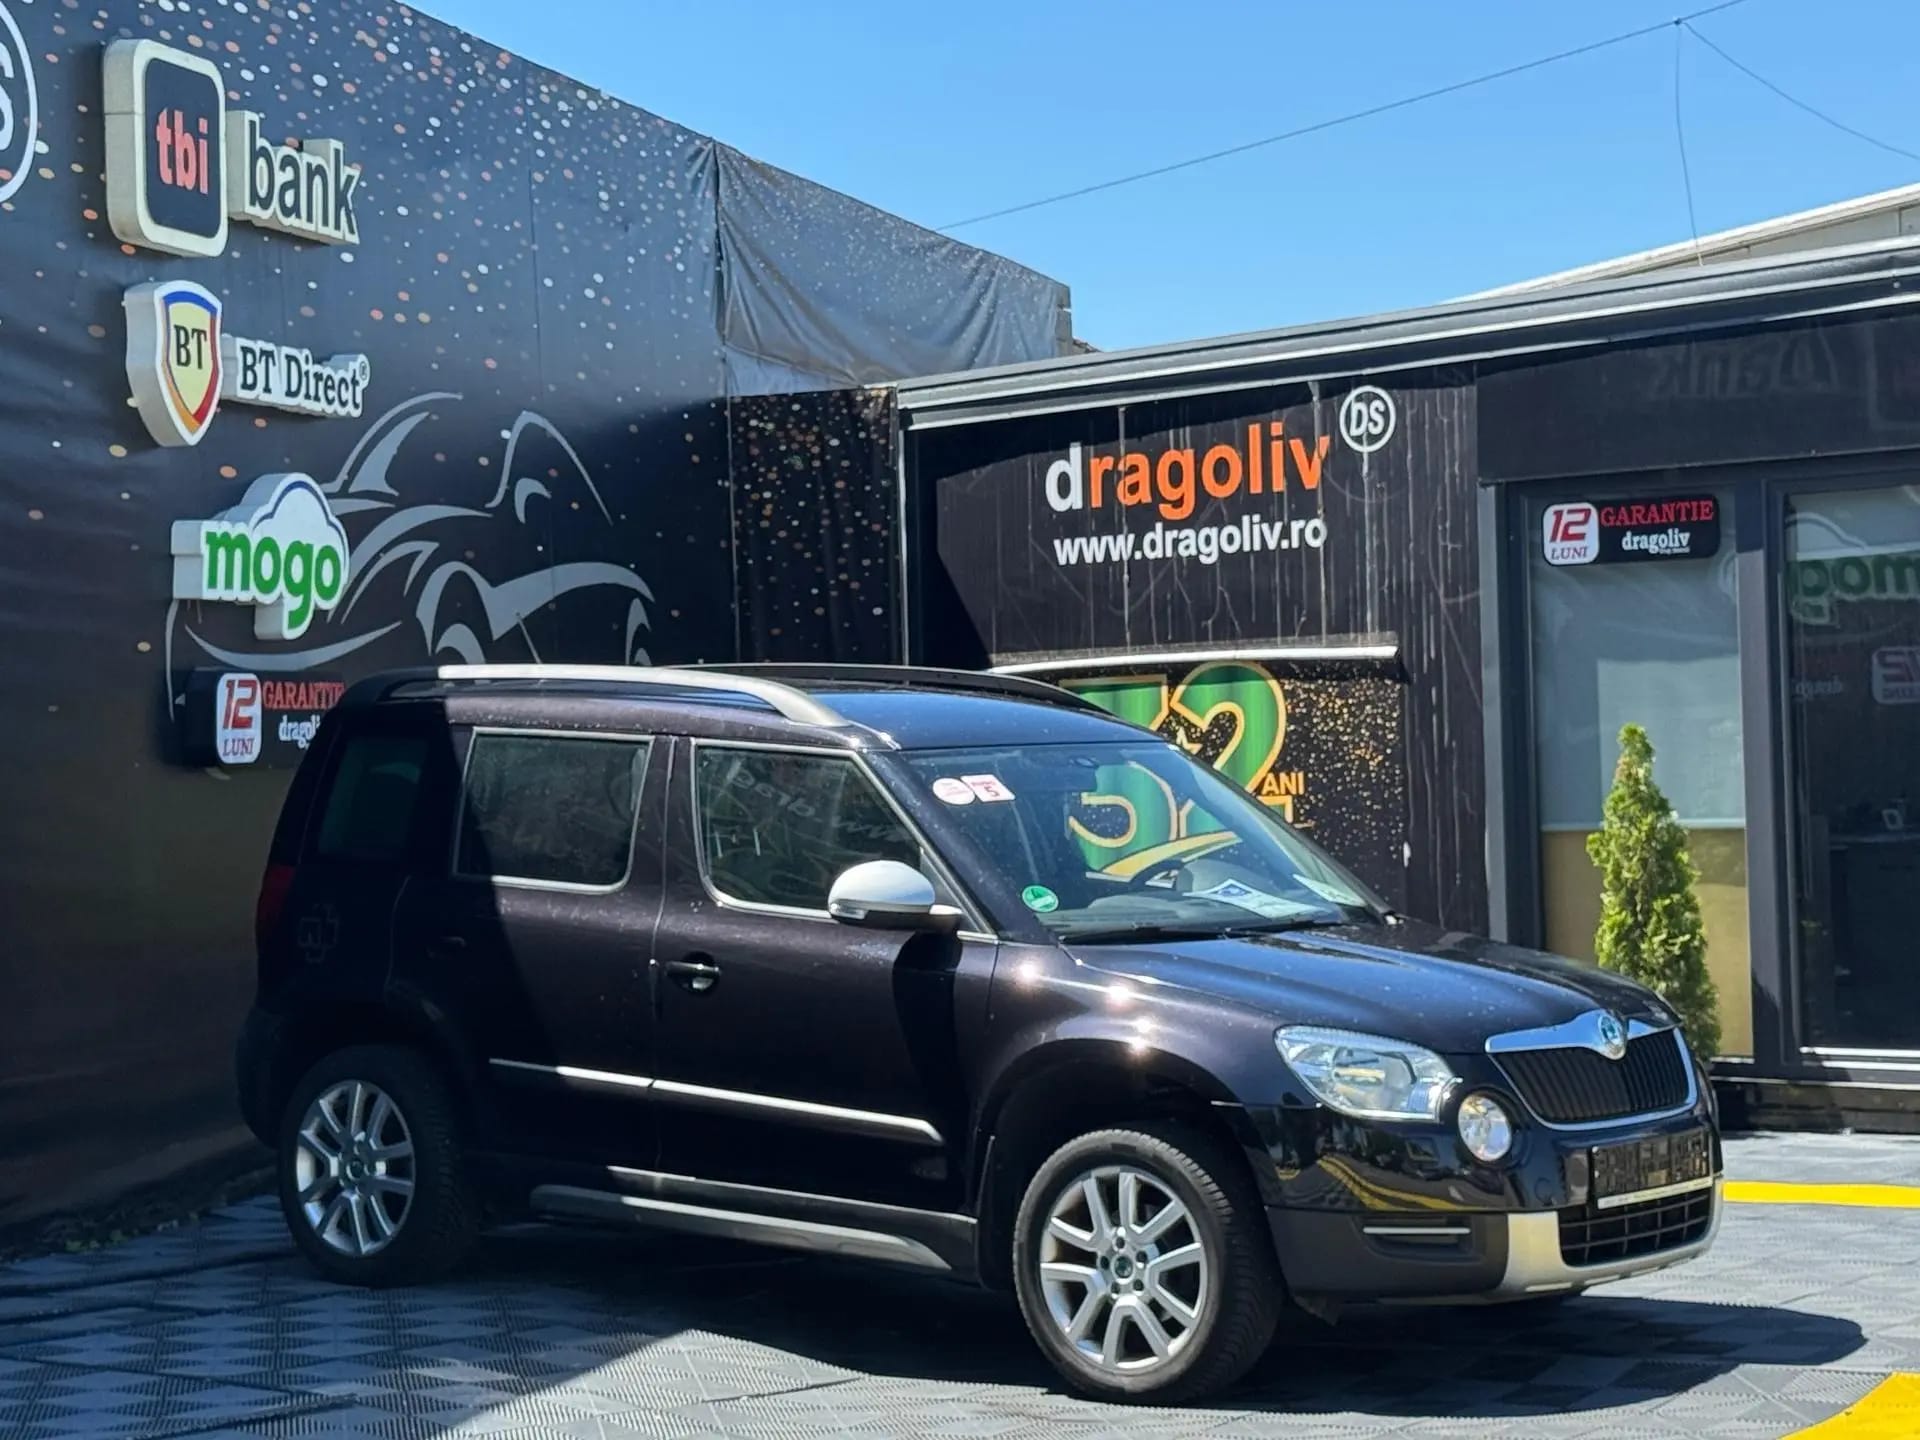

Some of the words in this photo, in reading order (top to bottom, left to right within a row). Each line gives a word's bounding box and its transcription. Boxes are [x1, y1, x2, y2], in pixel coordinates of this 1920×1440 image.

[156, 107, 209, 195] tbi
[248, 119, 361, 235] bank
[174, 324, 208, 369] BT
[240, 345, 276, 395] BT
[1350, 399, 1387, 437] DS
[1045, 421, 1331, 521] dragoliv
[1550, 508, 1592, 543] 12
[1600, 500, 1713, 527] GARANTIE
[1053, 514, 1328, 566] www.dragoliv.ro
[1551, 546, 1589, 561] LUNI
[1621, 528, 1691, 555] dragoliv
[205, 530, 341, 630] mogo
[222, 679, 258, 729] 12
[222, 737, 255, 757] LUNI
[278, 714, 321, 749] dragol
[1263, 771, 1305, 796] ANI
